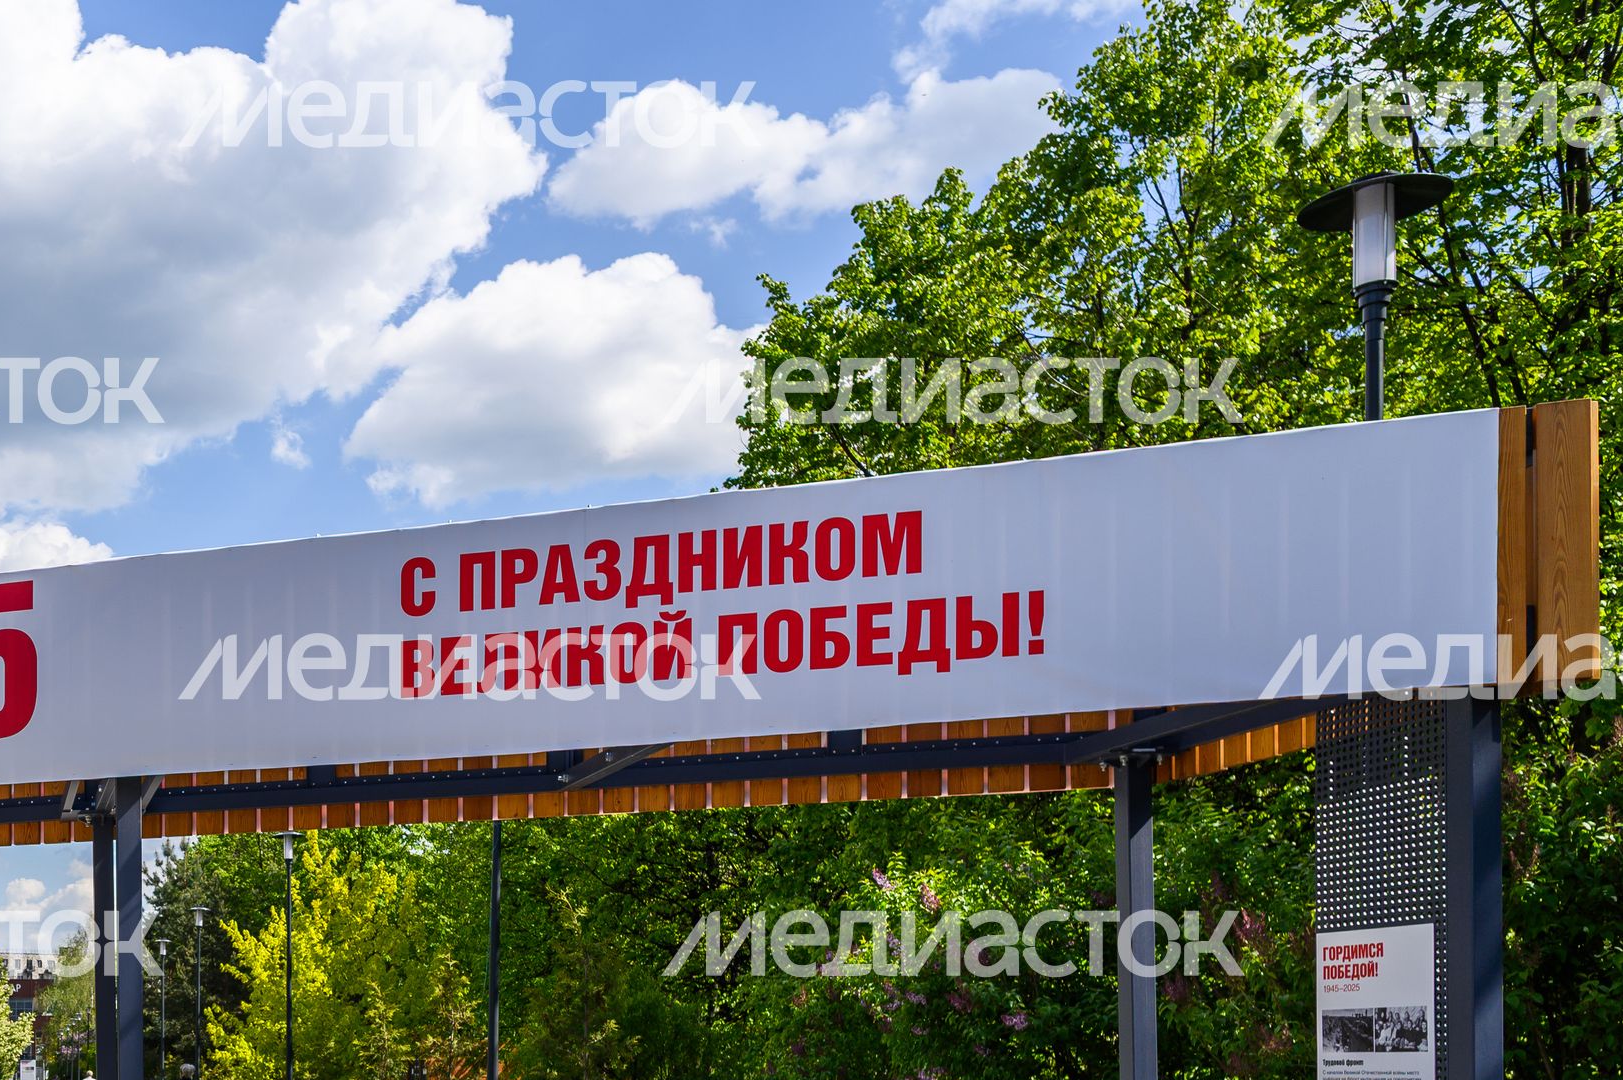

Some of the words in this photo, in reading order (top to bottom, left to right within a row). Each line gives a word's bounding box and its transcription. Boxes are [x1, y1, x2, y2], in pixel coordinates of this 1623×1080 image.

[400, 558, 436, 617] С
[459, 511, 923, 613] ПРАЗДНИКОМ
[400, 610, 694, 698] ВЕЛИКОЙ
[718, 591, 1045, 676] ПОБЕДЫ!
[1323, 943, 1384, 962] ГОРДИМСЯ
[1323, 961, 1379, 980] ПОБЕДОЙ!
